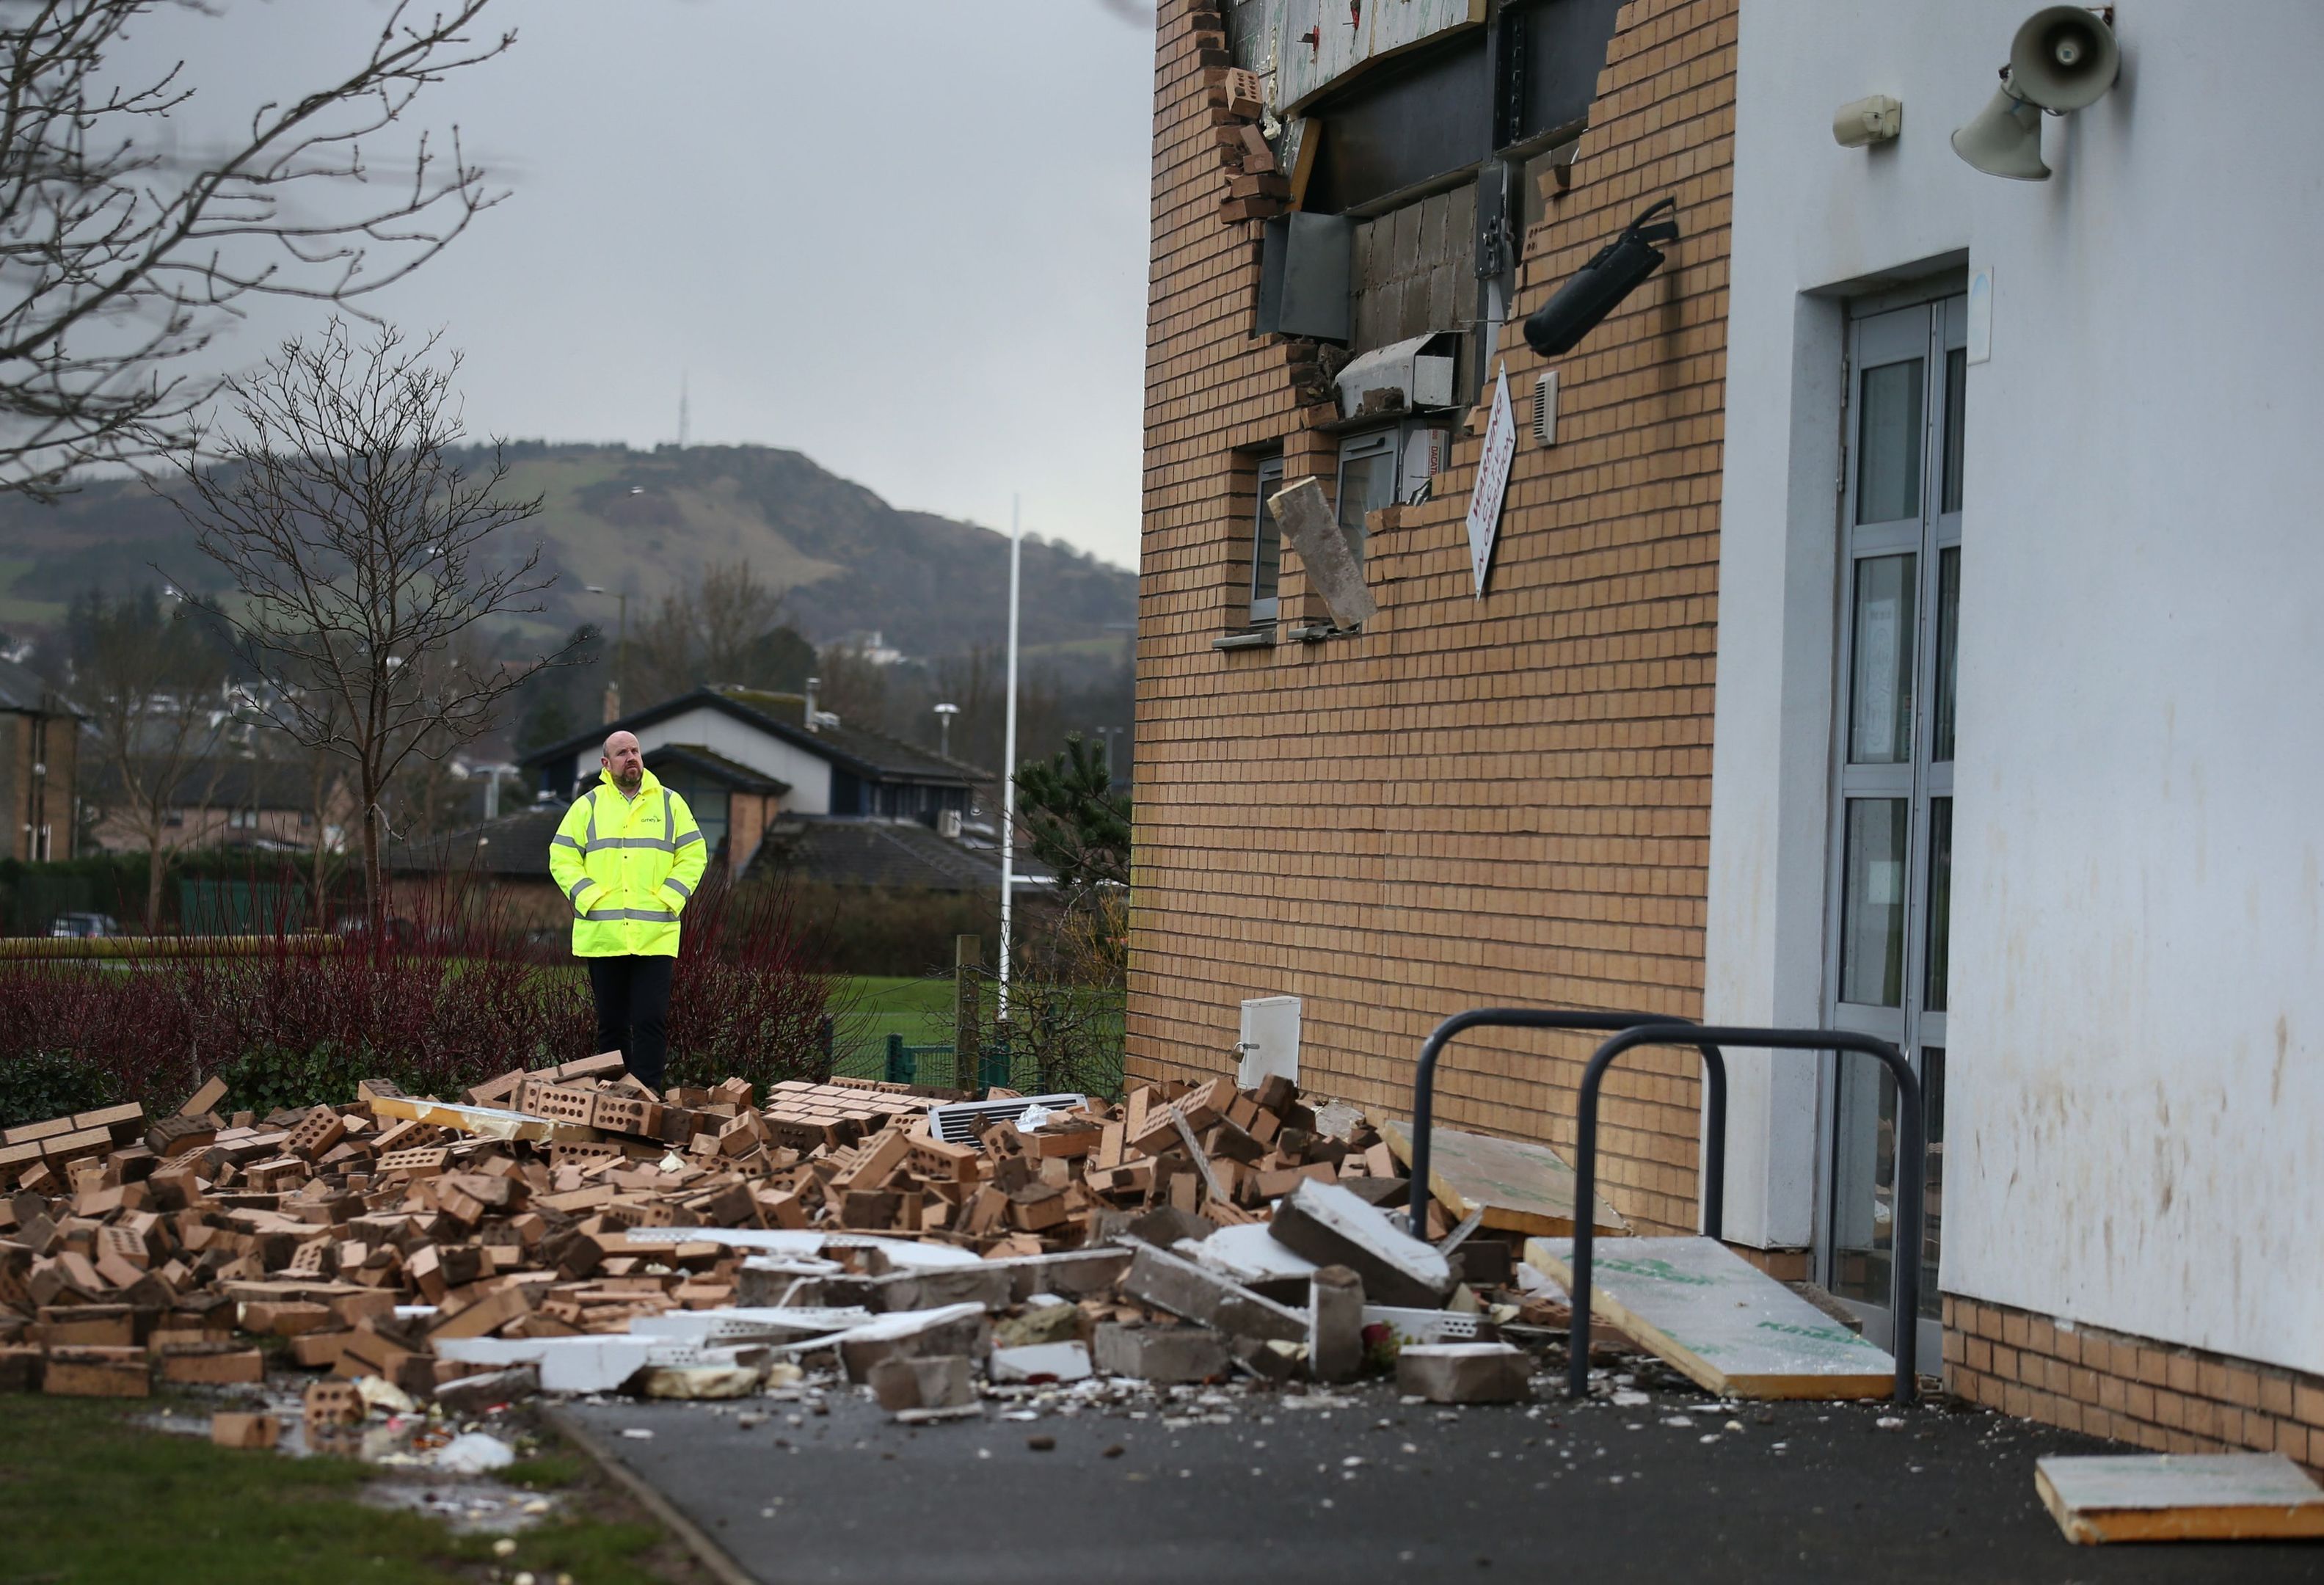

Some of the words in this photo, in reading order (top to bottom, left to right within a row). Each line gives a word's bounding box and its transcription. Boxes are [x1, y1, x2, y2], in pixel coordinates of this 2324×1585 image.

[1474, 391, 1502, 518] WARNING
[1478, 549, 1485, 577] IN
[1484, 429, 1512, 547] OPERATION
